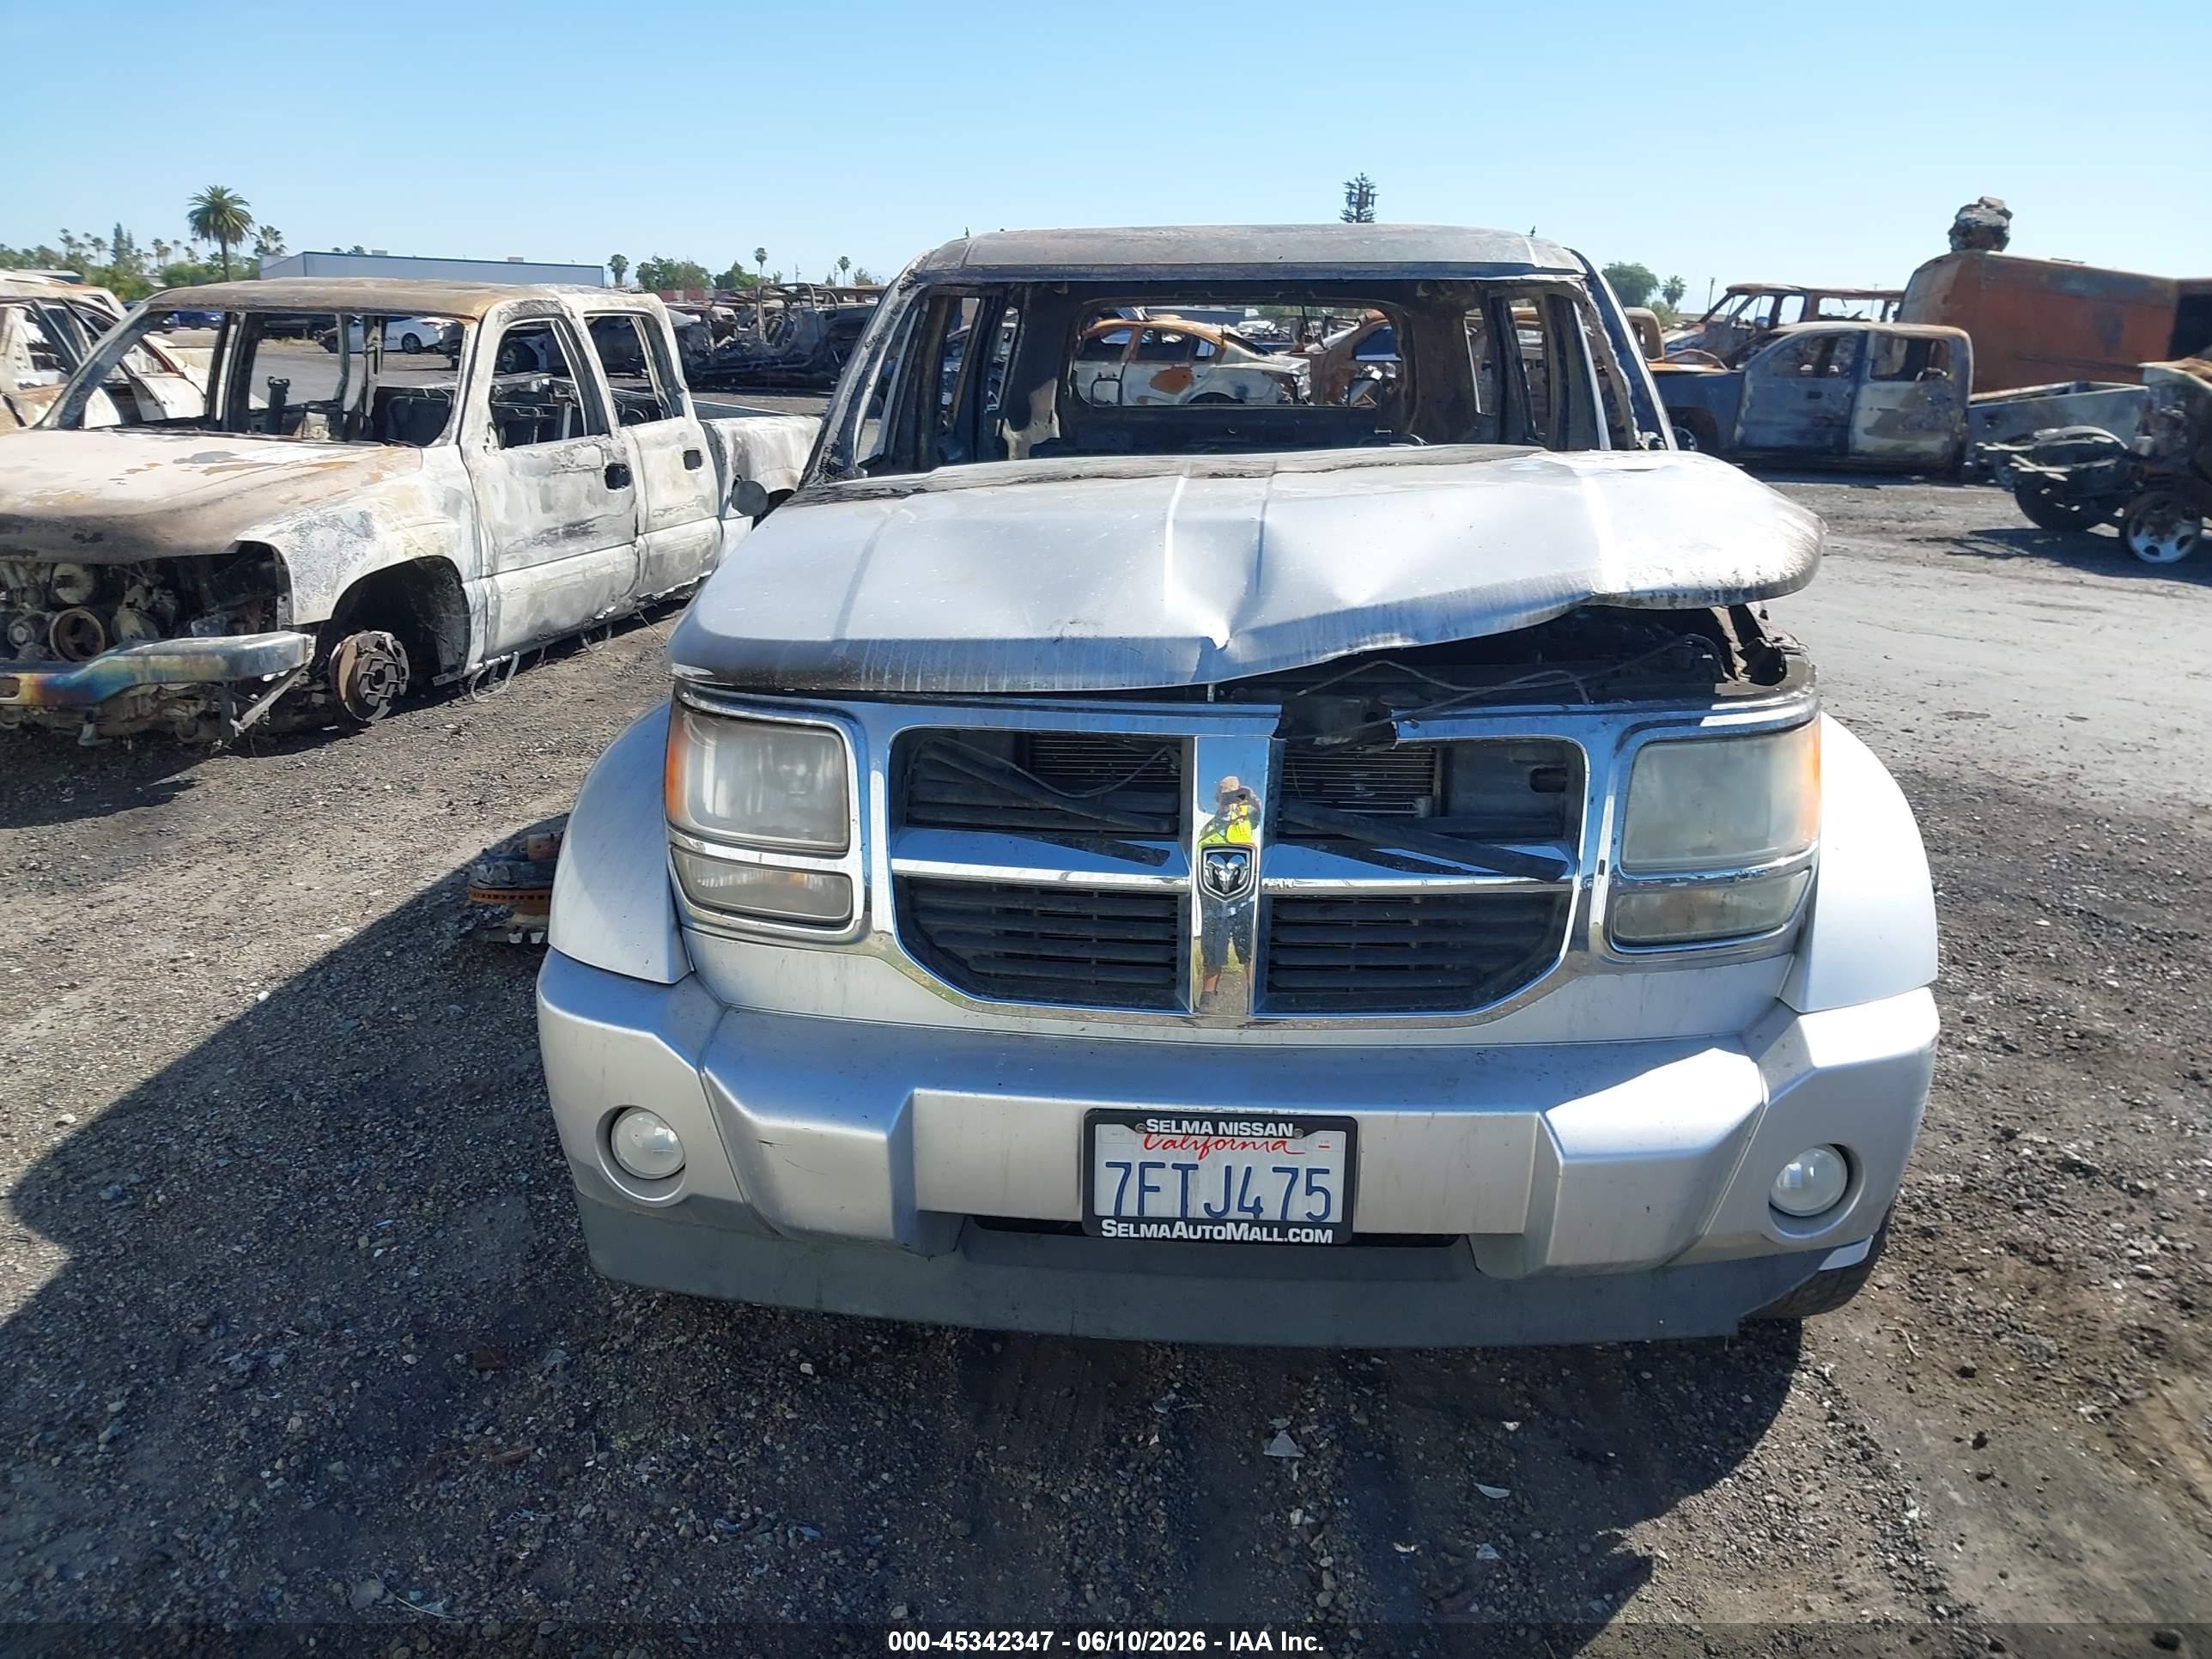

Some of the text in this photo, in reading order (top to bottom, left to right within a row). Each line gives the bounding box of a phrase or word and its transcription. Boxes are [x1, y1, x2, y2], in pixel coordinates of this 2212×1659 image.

[1146, 1118, 1293, 1137] SELMA NISSAN
[1144, 1133, 1305, 1161] California
[1105, 1161, 1331, 1222] 7FTJ475
